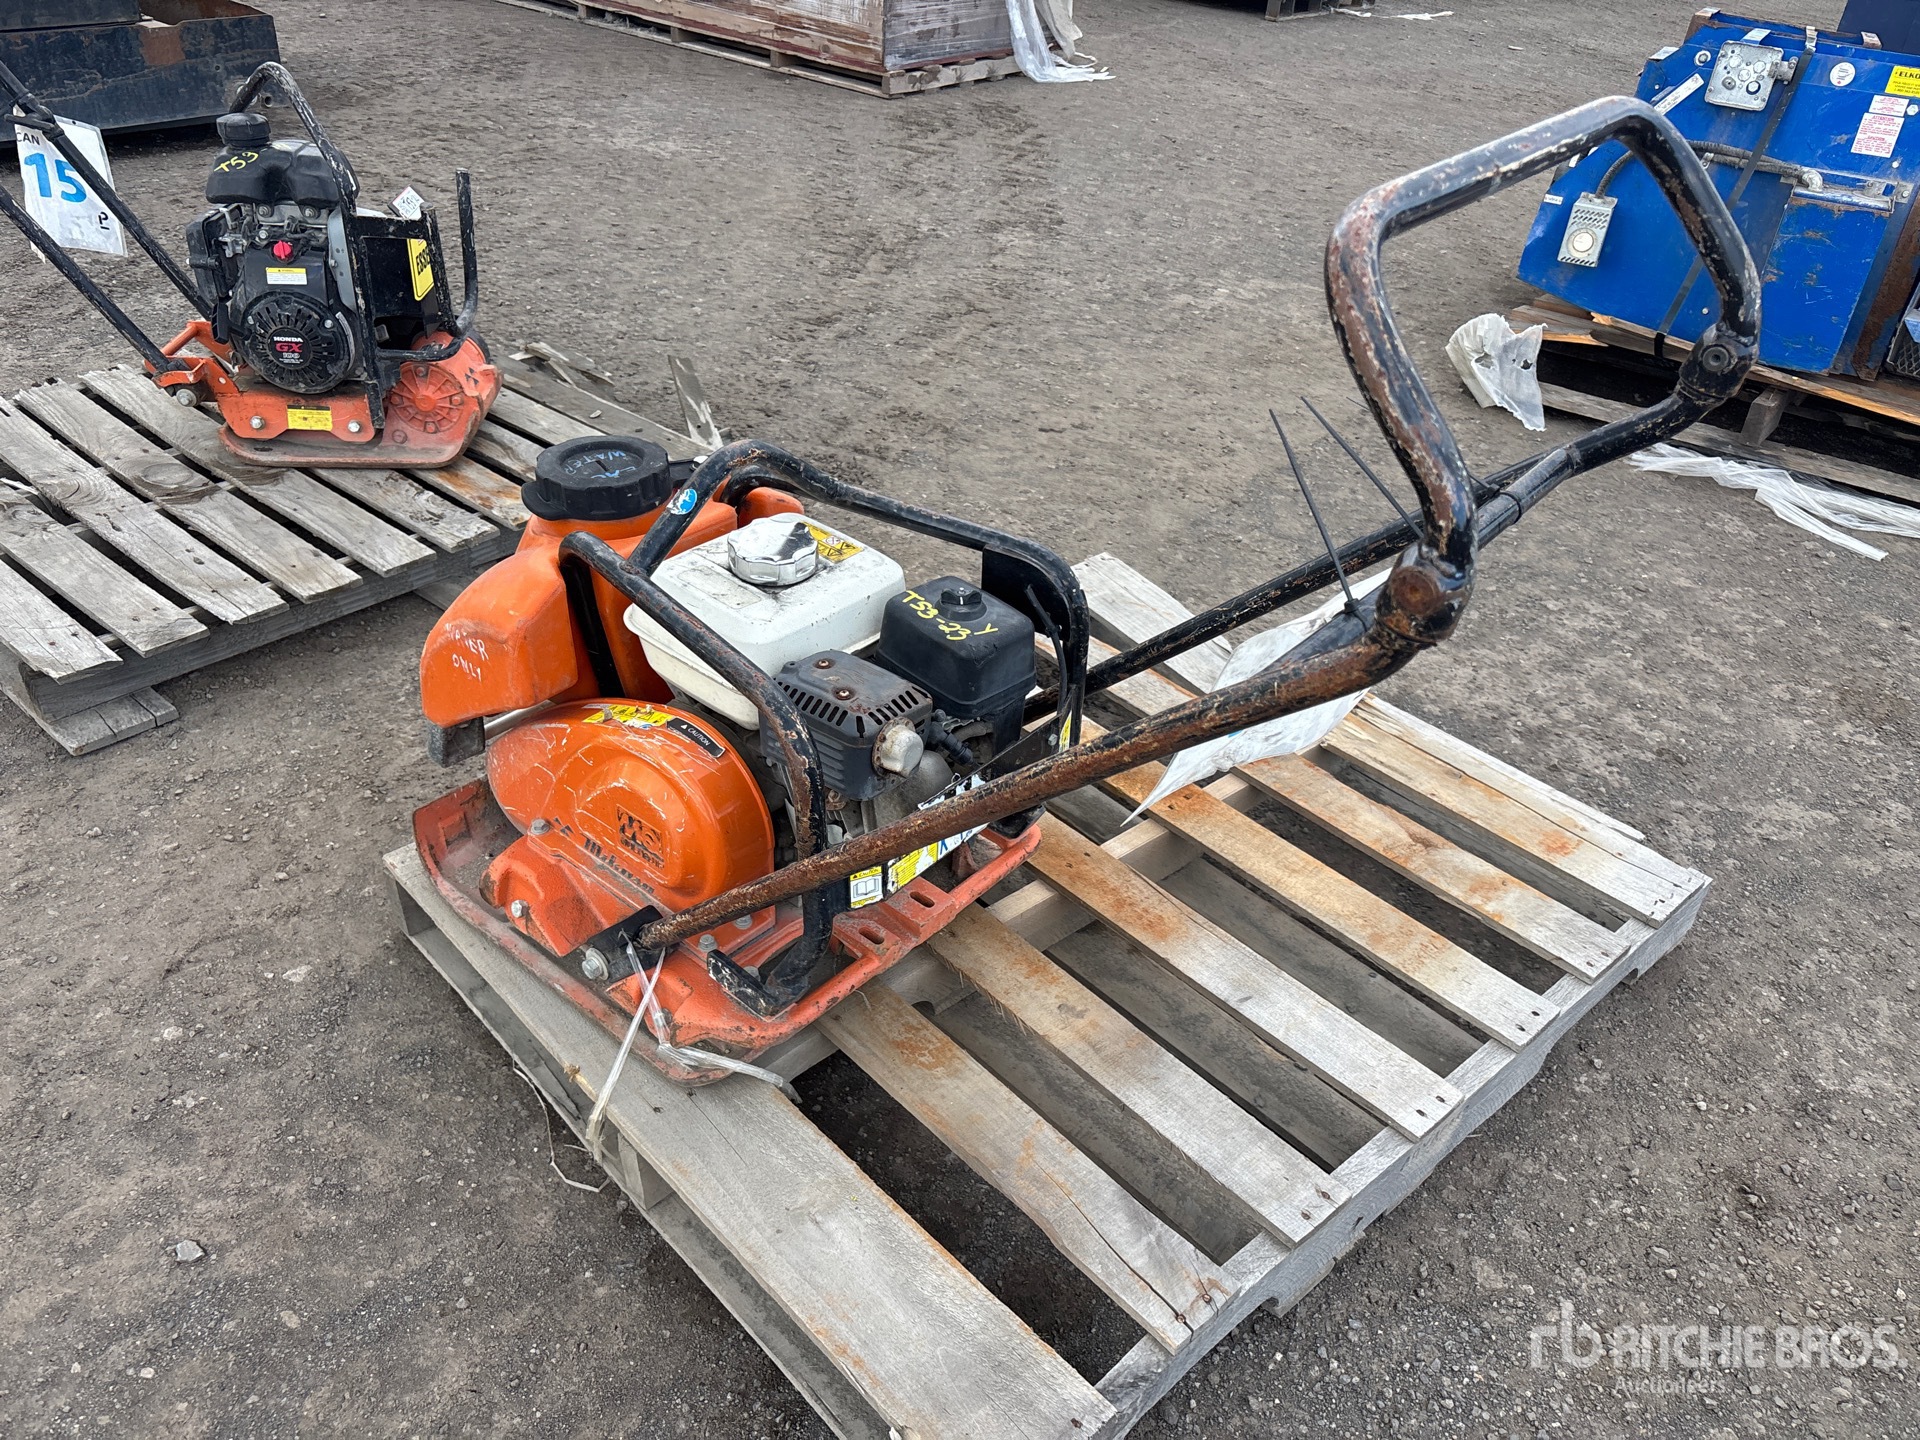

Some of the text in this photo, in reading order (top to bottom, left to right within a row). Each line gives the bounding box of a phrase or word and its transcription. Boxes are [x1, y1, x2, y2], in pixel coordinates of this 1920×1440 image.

[24, 152, 87, 203] 15
[275, 342, 303, 353] GX
[564, 450, 627, 476] WATER
[451, 652, 482, 682] ONLY
[687, 726, 711, 746] CAUTION
[858, 868, 879, 878] CAUTION
